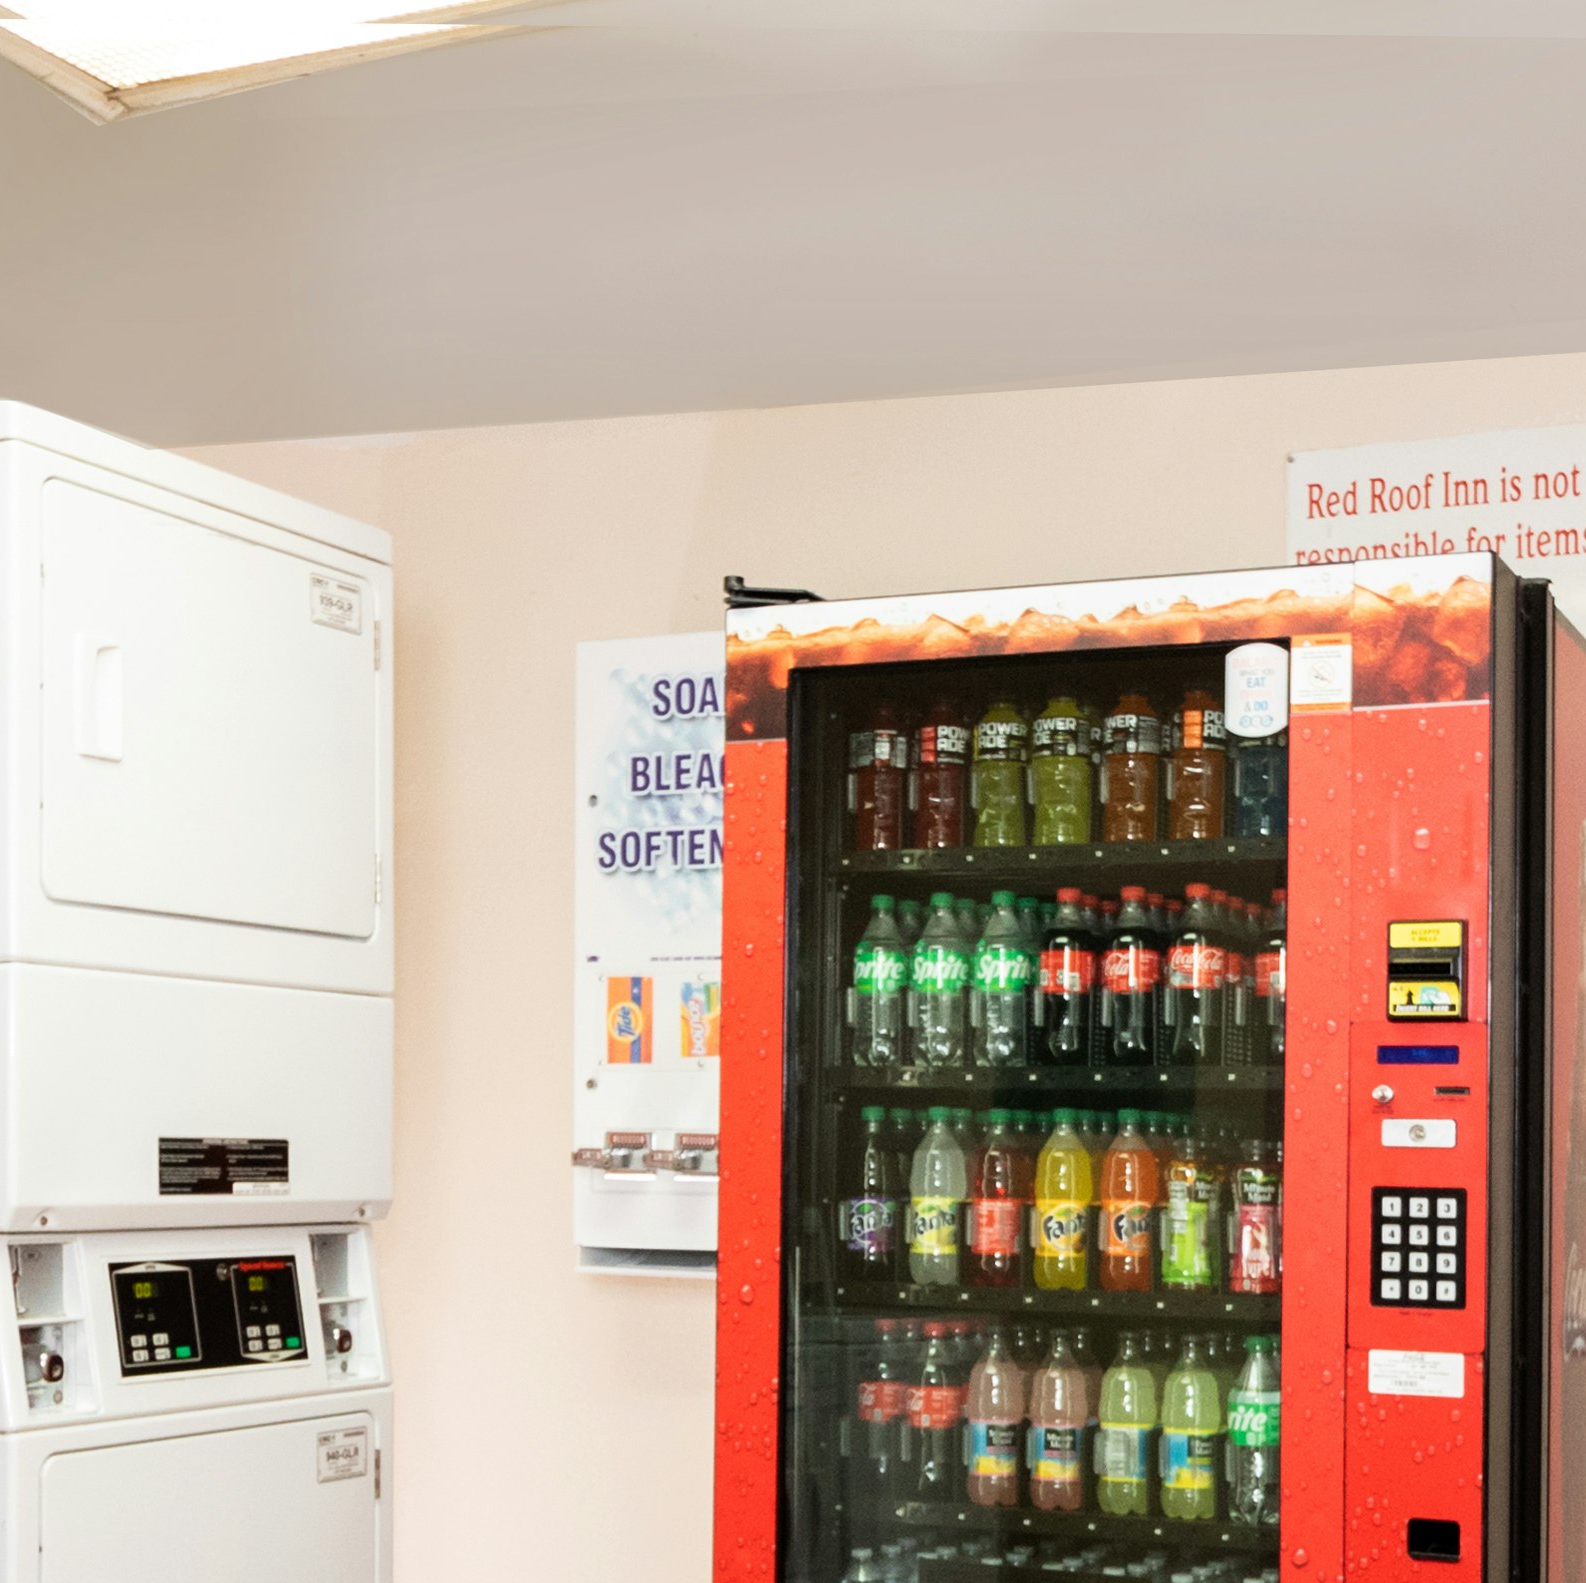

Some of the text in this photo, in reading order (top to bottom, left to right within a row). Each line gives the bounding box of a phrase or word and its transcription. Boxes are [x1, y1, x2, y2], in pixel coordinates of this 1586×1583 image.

[1306, 465, 1580, 519] Red Roof Inn is not
[1246, 677, 1266, 688] EAT
[630, 753, 726, 792] BLEA
[616, 1006, 632, 1038] Tide
[1417, 1204, 1423, 1212] 2
[1444, 1204, 1450, 1213] 3
[1388, 1230, 1450, 1240] 4 5 6
[1388, 1257, 1450, 1268] 7 8 9
[1415, 1285, 1422, 1294] 0
